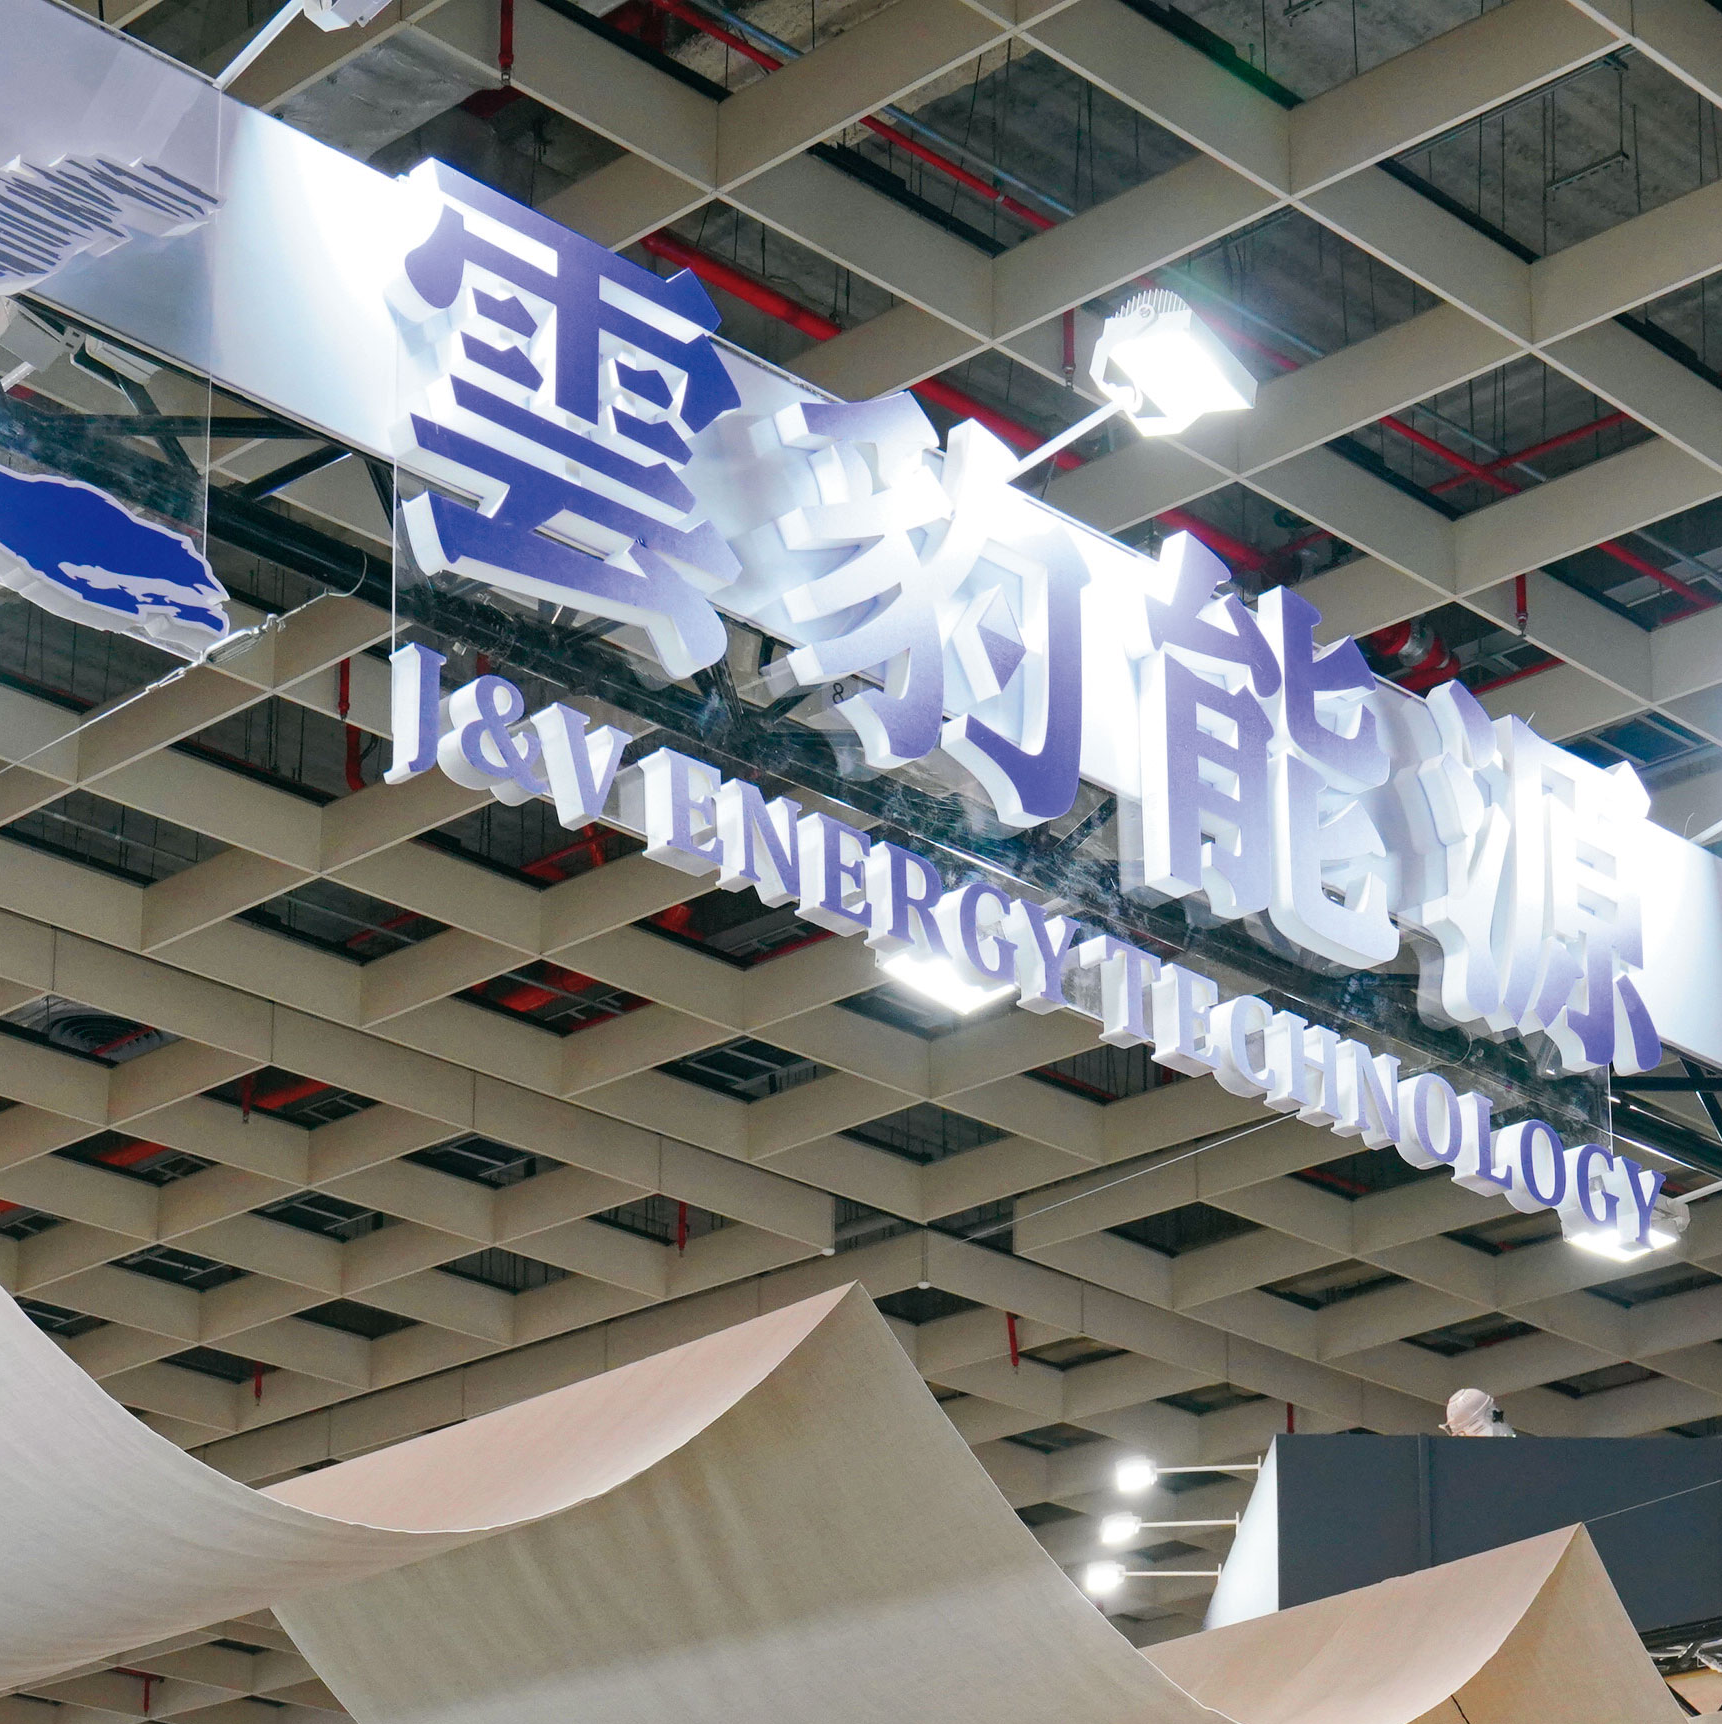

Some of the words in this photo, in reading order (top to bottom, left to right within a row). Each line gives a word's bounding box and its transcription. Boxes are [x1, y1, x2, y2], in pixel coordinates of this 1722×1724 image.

[384, 645, 631, 831] J&V
[642, 747, 1083, 1013] ENERGY
[1083, 935, 1667, 1249] TECHNOLOGY
[392, 155, 1669, 1075] 雲豹能源
